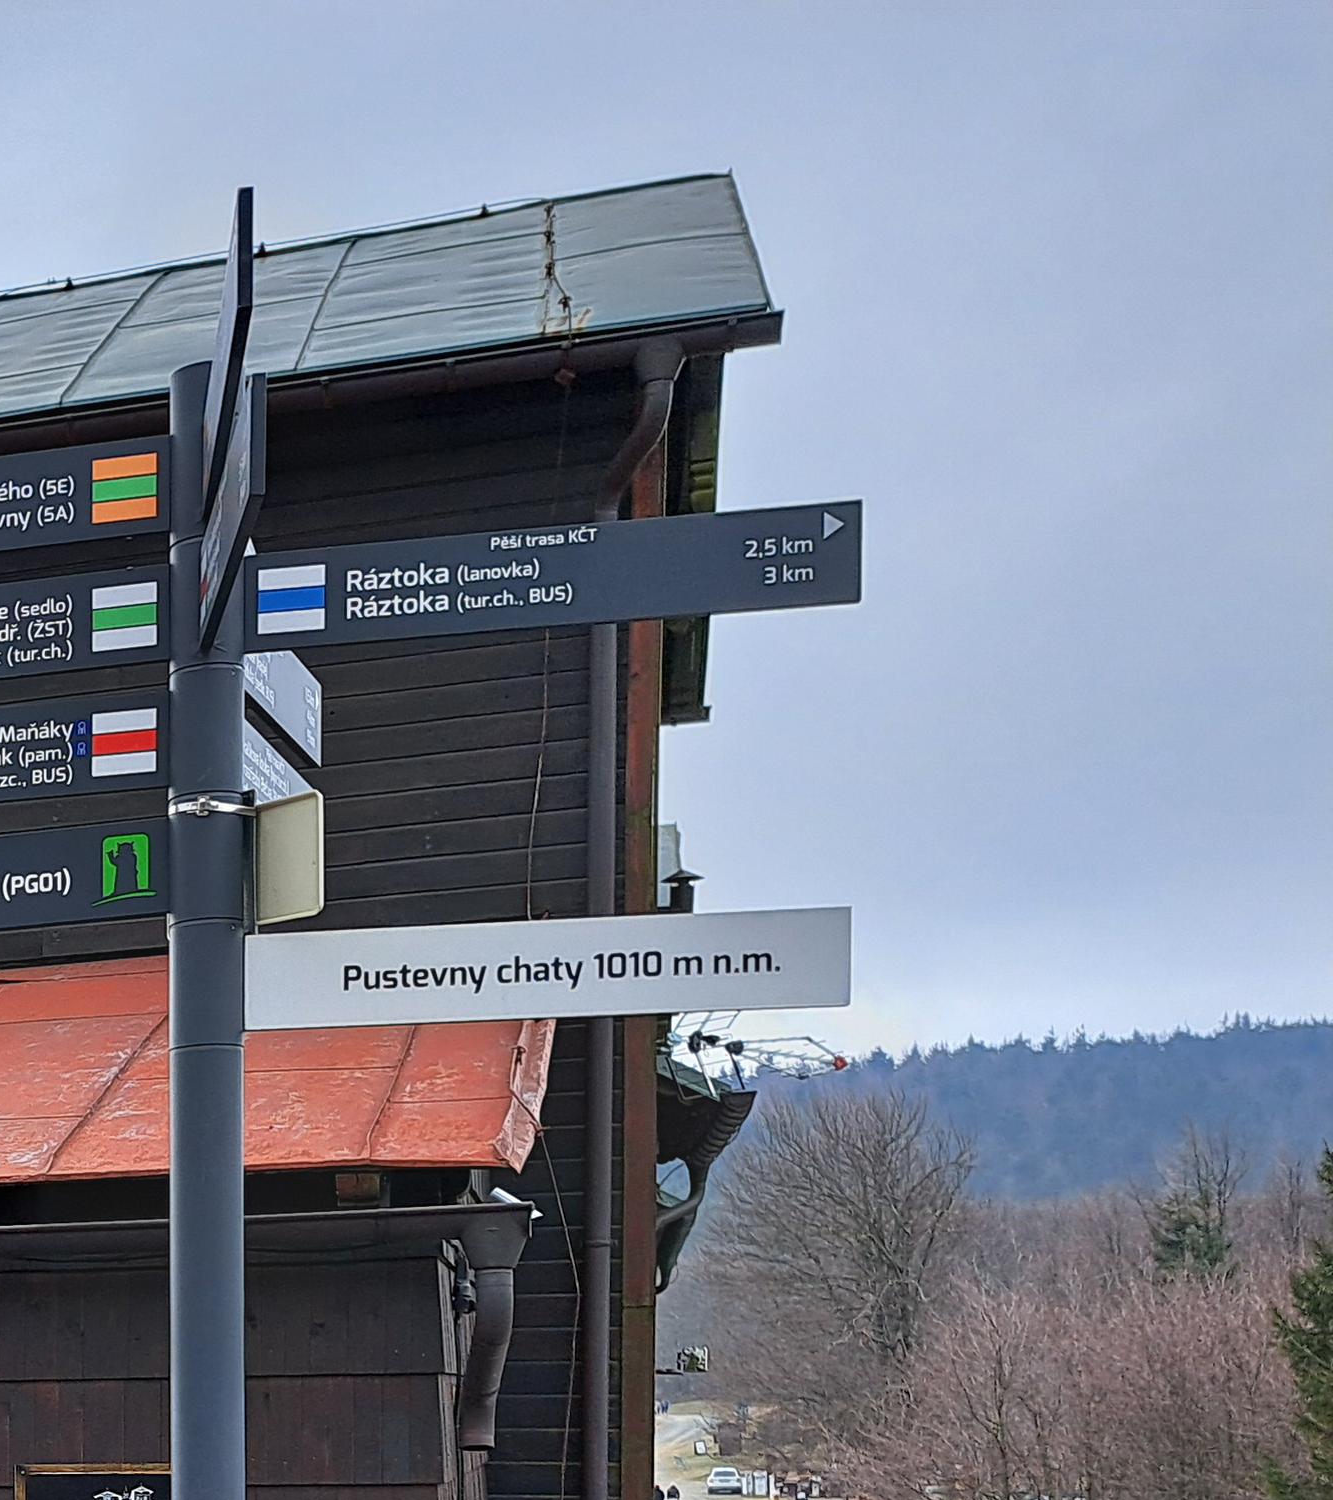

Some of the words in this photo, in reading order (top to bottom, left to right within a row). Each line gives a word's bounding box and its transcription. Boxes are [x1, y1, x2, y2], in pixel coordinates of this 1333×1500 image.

[39, 475, 75, 500] (5E)
[36, 502, 75, 527] (5A)
[490, 534, 522, 551] Pěší
[525, 533, 565, 548] trasa
[568, 526, 598, 543] KČT
[782, 535, 813, 555] km
[346, 562, 450, 593] Ráztoka
[456, 557, 541, 586] (lanovka)
[763, 566, 777, 585] 3
[782, 563, 814, 583] km
[14, 594, 73, 621] (sedlo)
[346, 589, 449, 620] Ráztoka
[456, 591, 524, 614] (tur.ch.,
[529, 582, 573, 605] BUS)
[27, 617, 73, 643] (ŽST)
[6, 640, 73, 667] (tur.ch.)
[18, 742, 74, 768] (pam.)
[32, 764, 74, 786] BUS)
[2, 867, 72, 901] (PG01)
[342, 963, 487, 994] Pustevny
[496, 955, 583, 990] chaty
[592, 951, 662, 979] 1010
[672, 955, 703, 977] m
[712, 951, 782, 976] n.m.
